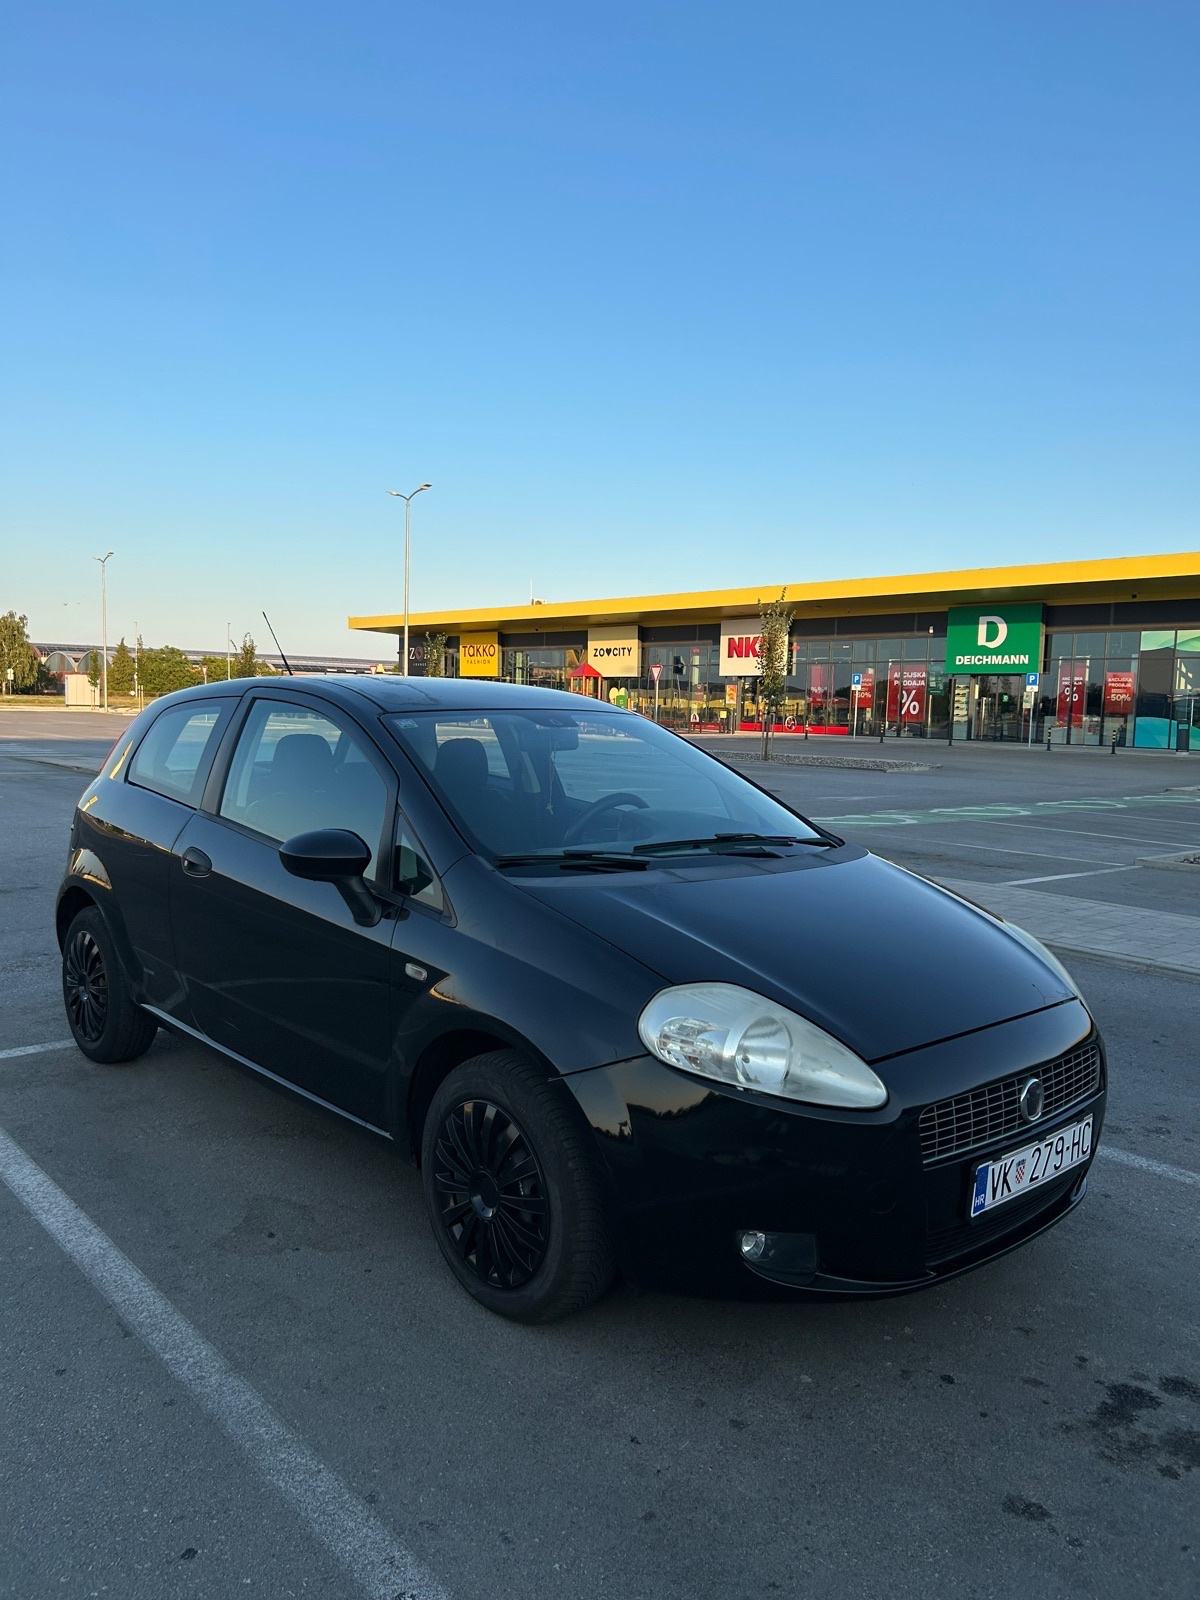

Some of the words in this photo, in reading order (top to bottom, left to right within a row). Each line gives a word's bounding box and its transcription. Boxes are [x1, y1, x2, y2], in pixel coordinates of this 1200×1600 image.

[977, 615, 1008, 649] D
[462, 644, 496, 657] TAKKO
[728, 637, 768, 658] NK
[955, 654, 1029, 665] DEICHMANN
[854, 675, 859, 683] P
[1029, 675, 1036, 683] P
[991, 1158, 1015, 1200] VK
[1029, 1121, 1091, 1183] 279-HC
[974, 1193, 985, 1207] HR
